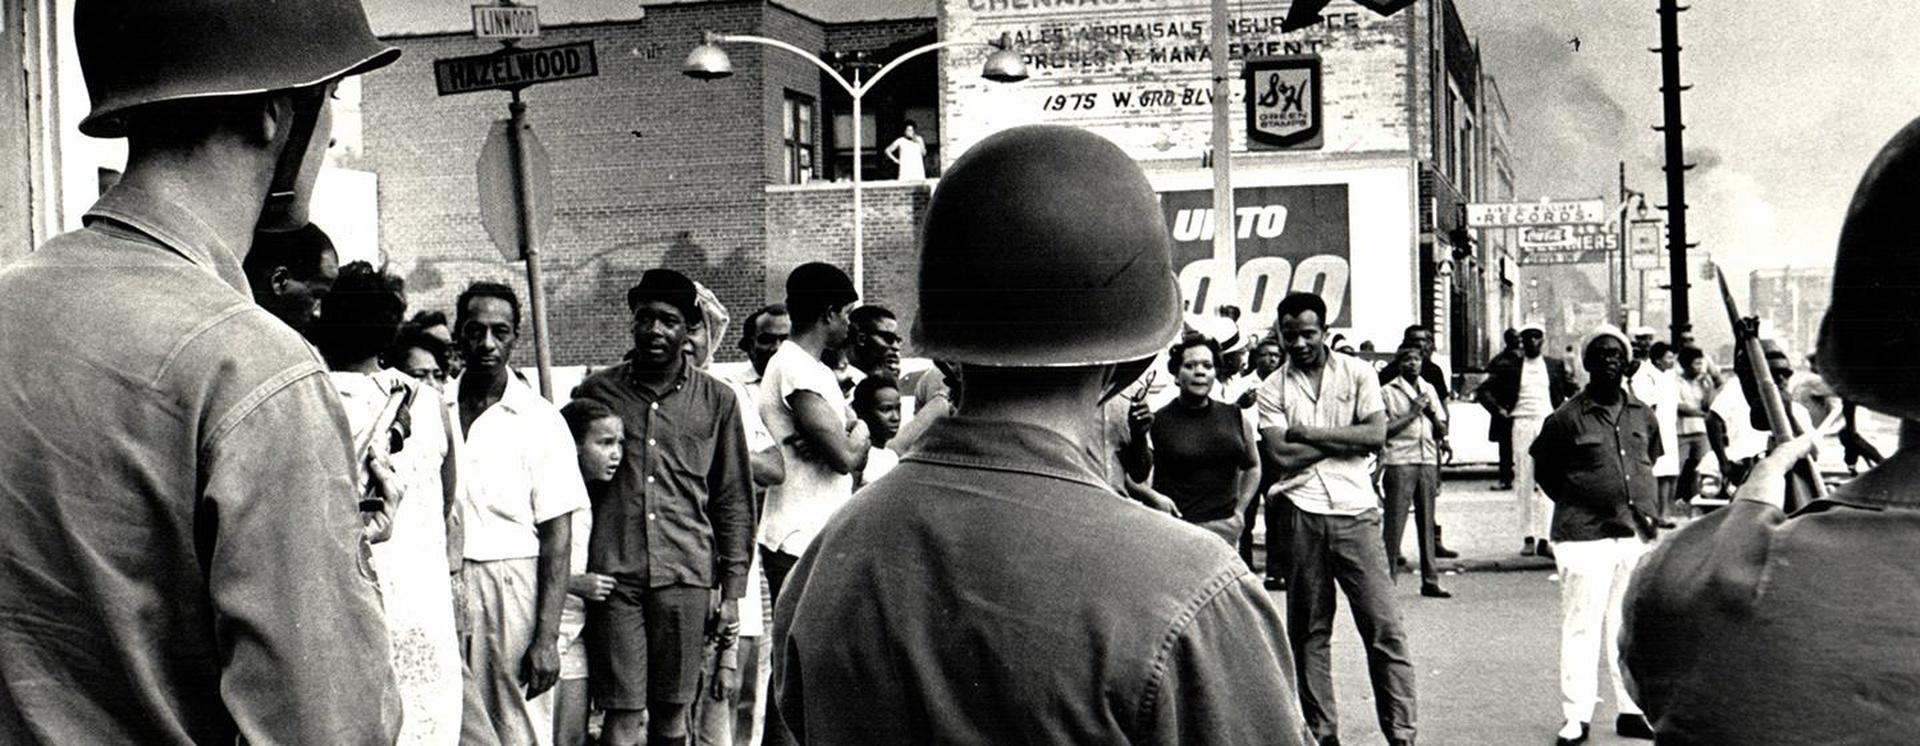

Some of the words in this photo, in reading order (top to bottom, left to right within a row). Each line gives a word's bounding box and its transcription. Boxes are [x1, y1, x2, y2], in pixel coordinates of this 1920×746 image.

[481, 10, 533, 35] LINWOOD
[1003, 28, 1063, 48] ALES
[1151, 39, 1323, 63] MANAEMENT
[450, 48, 581, 90] HAZELWOOD
[1043, 93, 1097, 111] 1975
[1182, 88, 1216, 106] BLV
[1259, 112, 1307, 120] GREEN
[1260, 119, 1307, 128] STAMPS
[1236, 204, 1288, 239] TO
[1484, 208, 1585, 224] RECORDS
